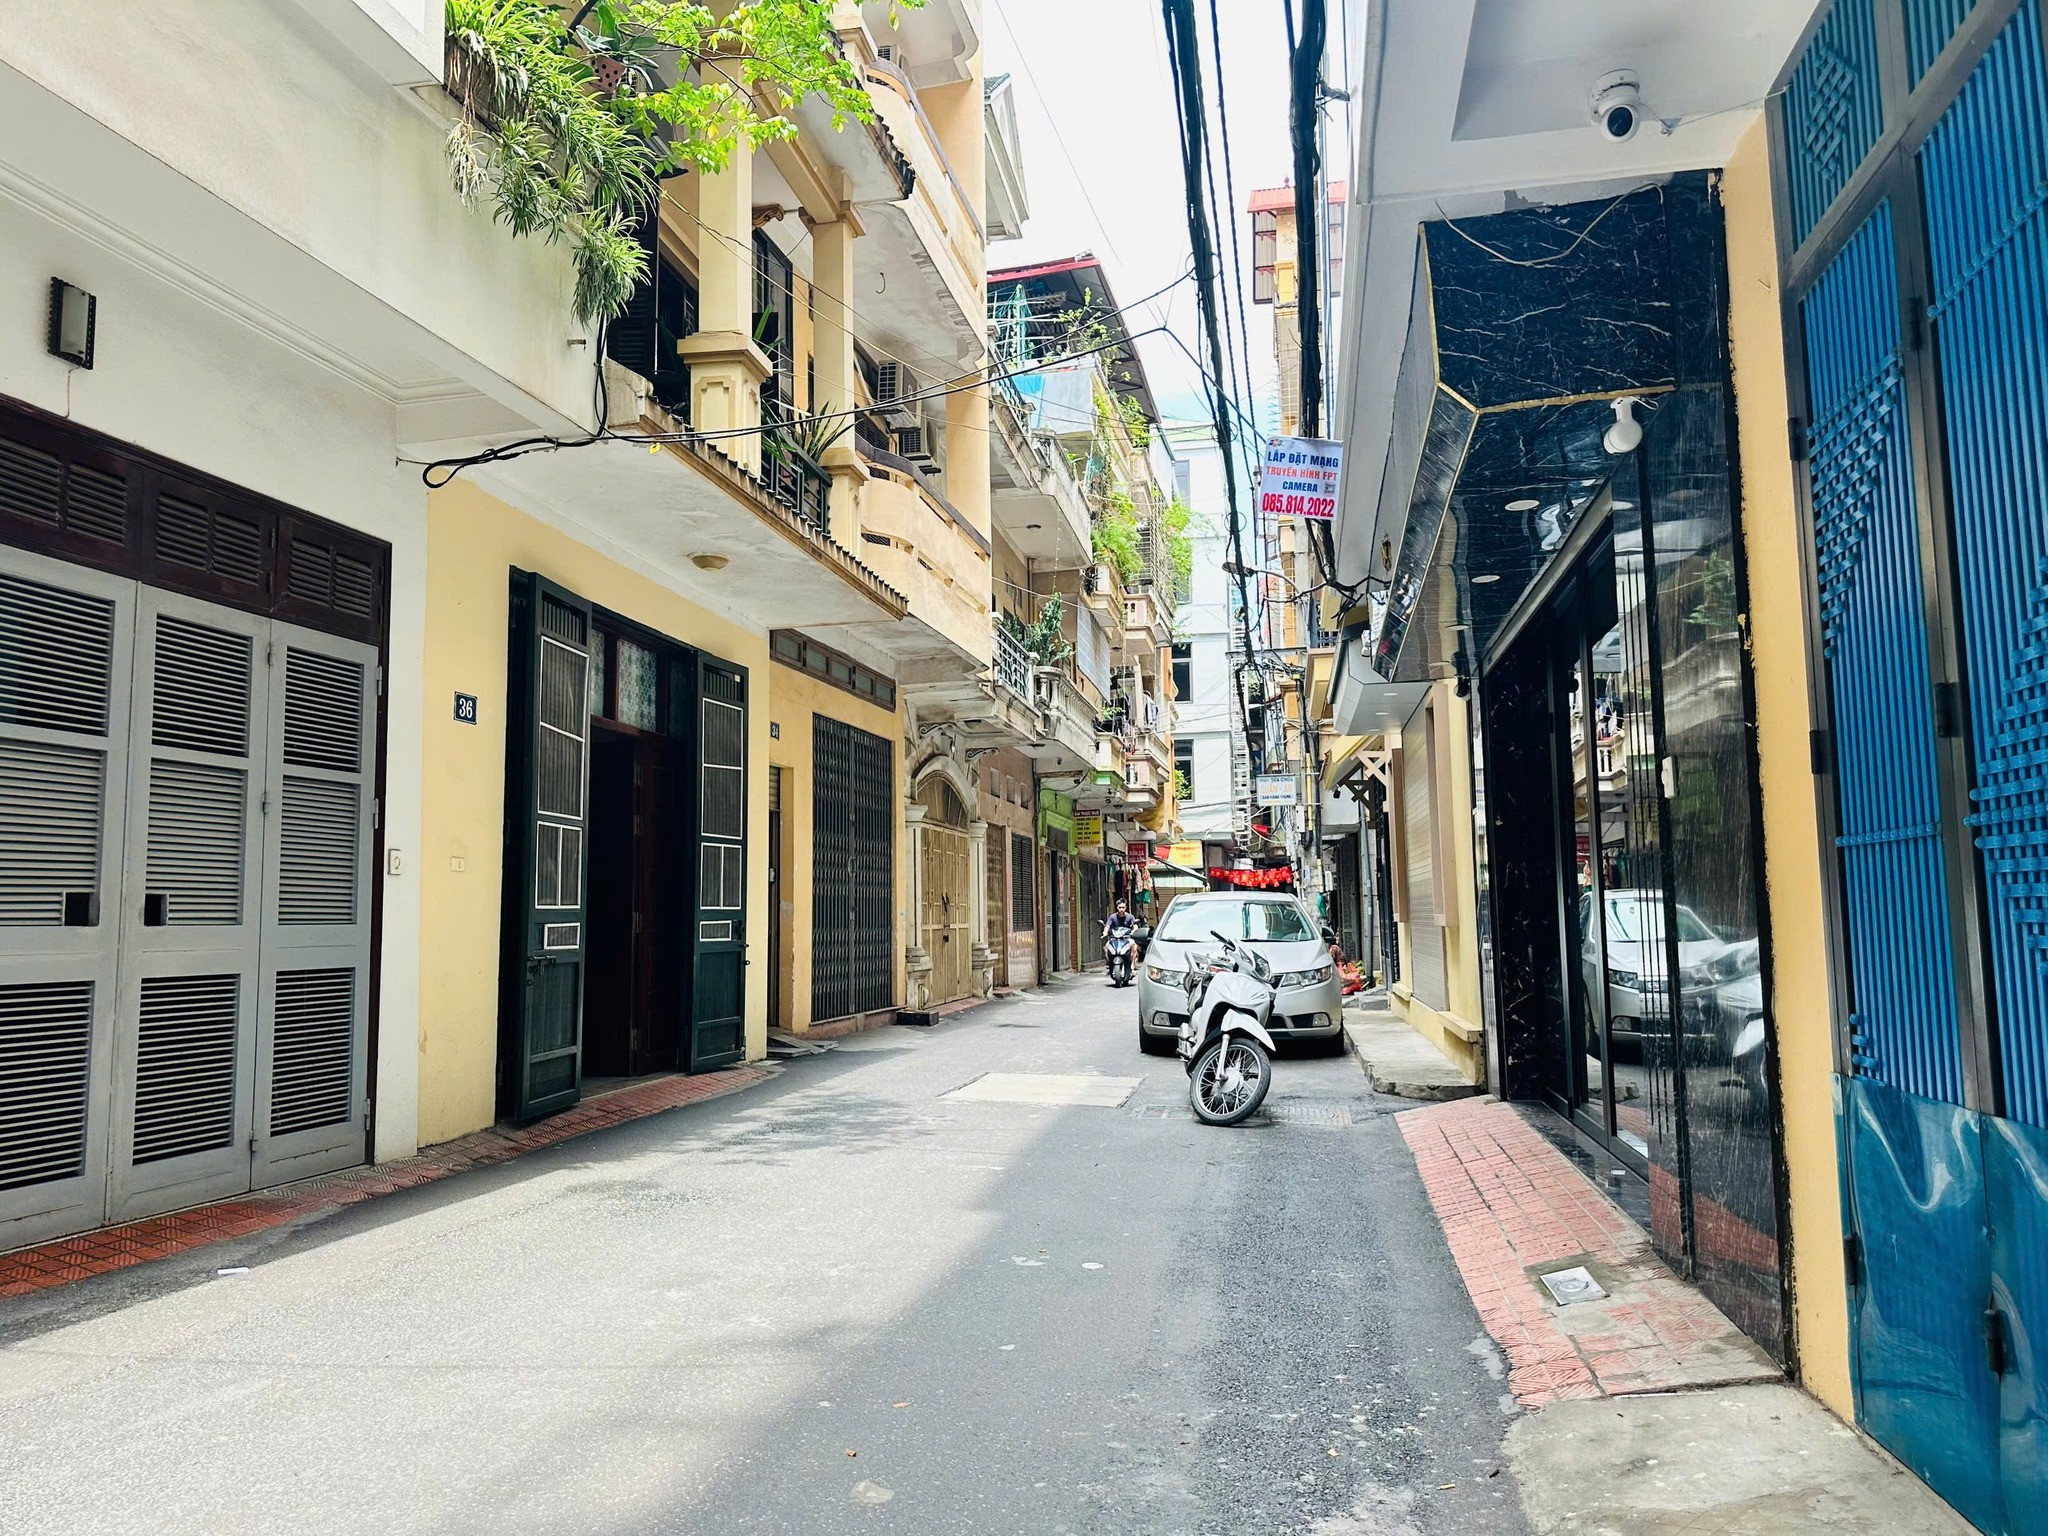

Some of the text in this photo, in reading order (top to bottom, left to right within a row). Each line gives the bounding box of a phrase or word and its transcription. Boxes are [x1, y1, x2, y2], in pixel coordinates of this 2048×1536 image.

[1289, 452, 1307, 465] ĐẶT
[1310, 455, 1339, 468] MẠNG
[1322, 471, 1337, 481] FPT
[1282, 481, 1318, 492] CAMERA
[1262, 493, 1335, 517] 085.814.2022
[459, 698, 473, 719] 36
